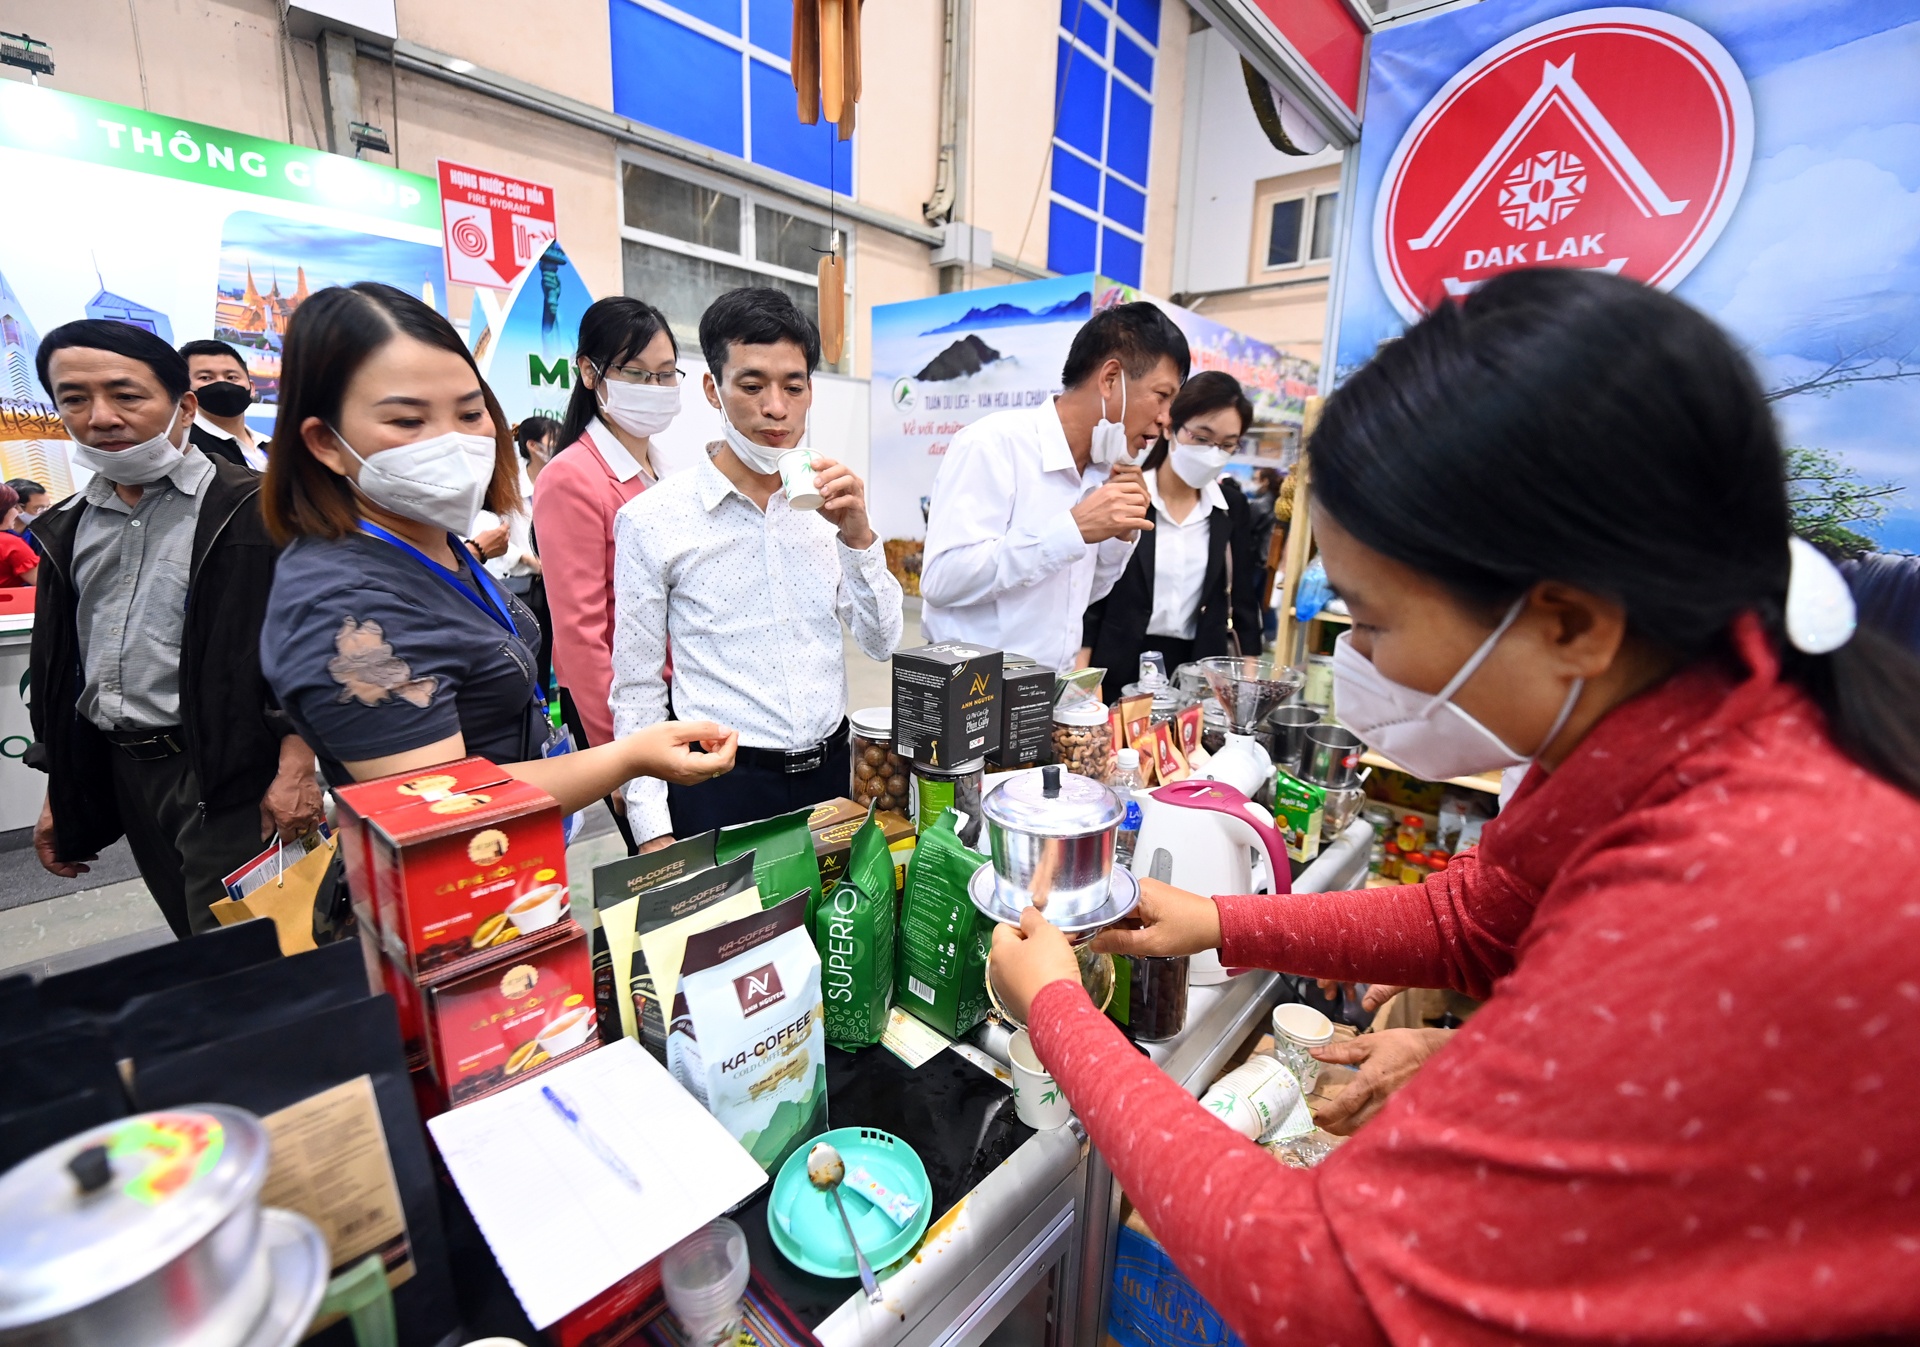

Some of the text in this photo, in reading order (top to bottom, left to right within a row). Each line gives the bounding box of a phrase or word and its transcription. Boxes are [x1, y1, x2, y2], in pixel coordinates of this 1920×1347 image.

[97, 118, 267, 178] THÔNG
[467, 192, 531, 215] FIRE HYDRANT
[1463, 232, 1607, 271] DAK LAK
[961, 701, 973, 709] ANH
[627, 859, 686, 887] KA-COFFEE
[631, 868, 683, 893] Honey method
[671, 882, 728, 912] KA-COFFEE
[674, 891, 725, 917] Honey method
[718, 921, 778, 953] KA-COFFEE
[721, 931, 774, 959] Honey method
[722, 1009, 811, 1073] KA-COFFEE
[733, 1064, 757, 1079] COLD
